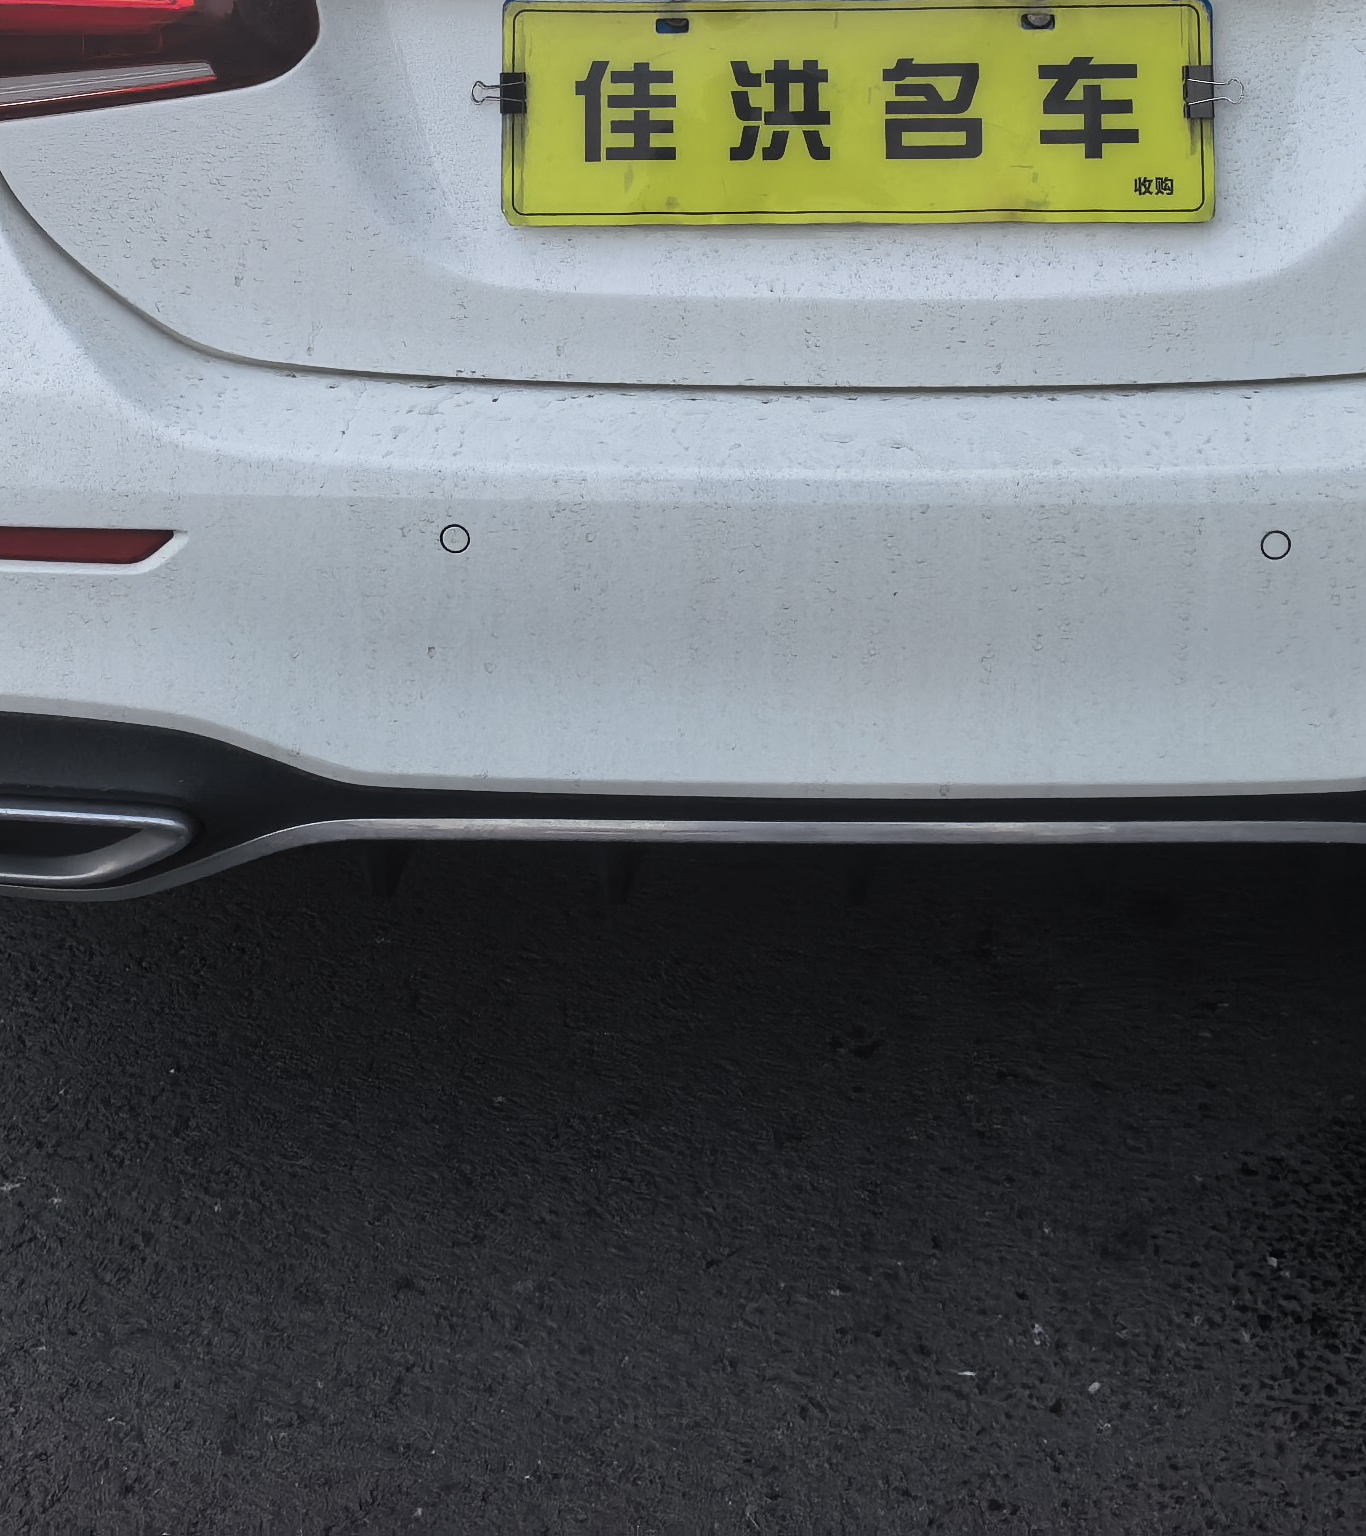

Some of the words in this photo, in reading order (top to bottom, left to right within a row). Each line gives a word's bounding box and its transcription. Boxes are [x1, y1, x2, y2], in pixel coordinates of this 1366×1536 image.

[574, 56, 1141, 163] 佳洪名车
[1133, 176, 1175, 197] 收购
